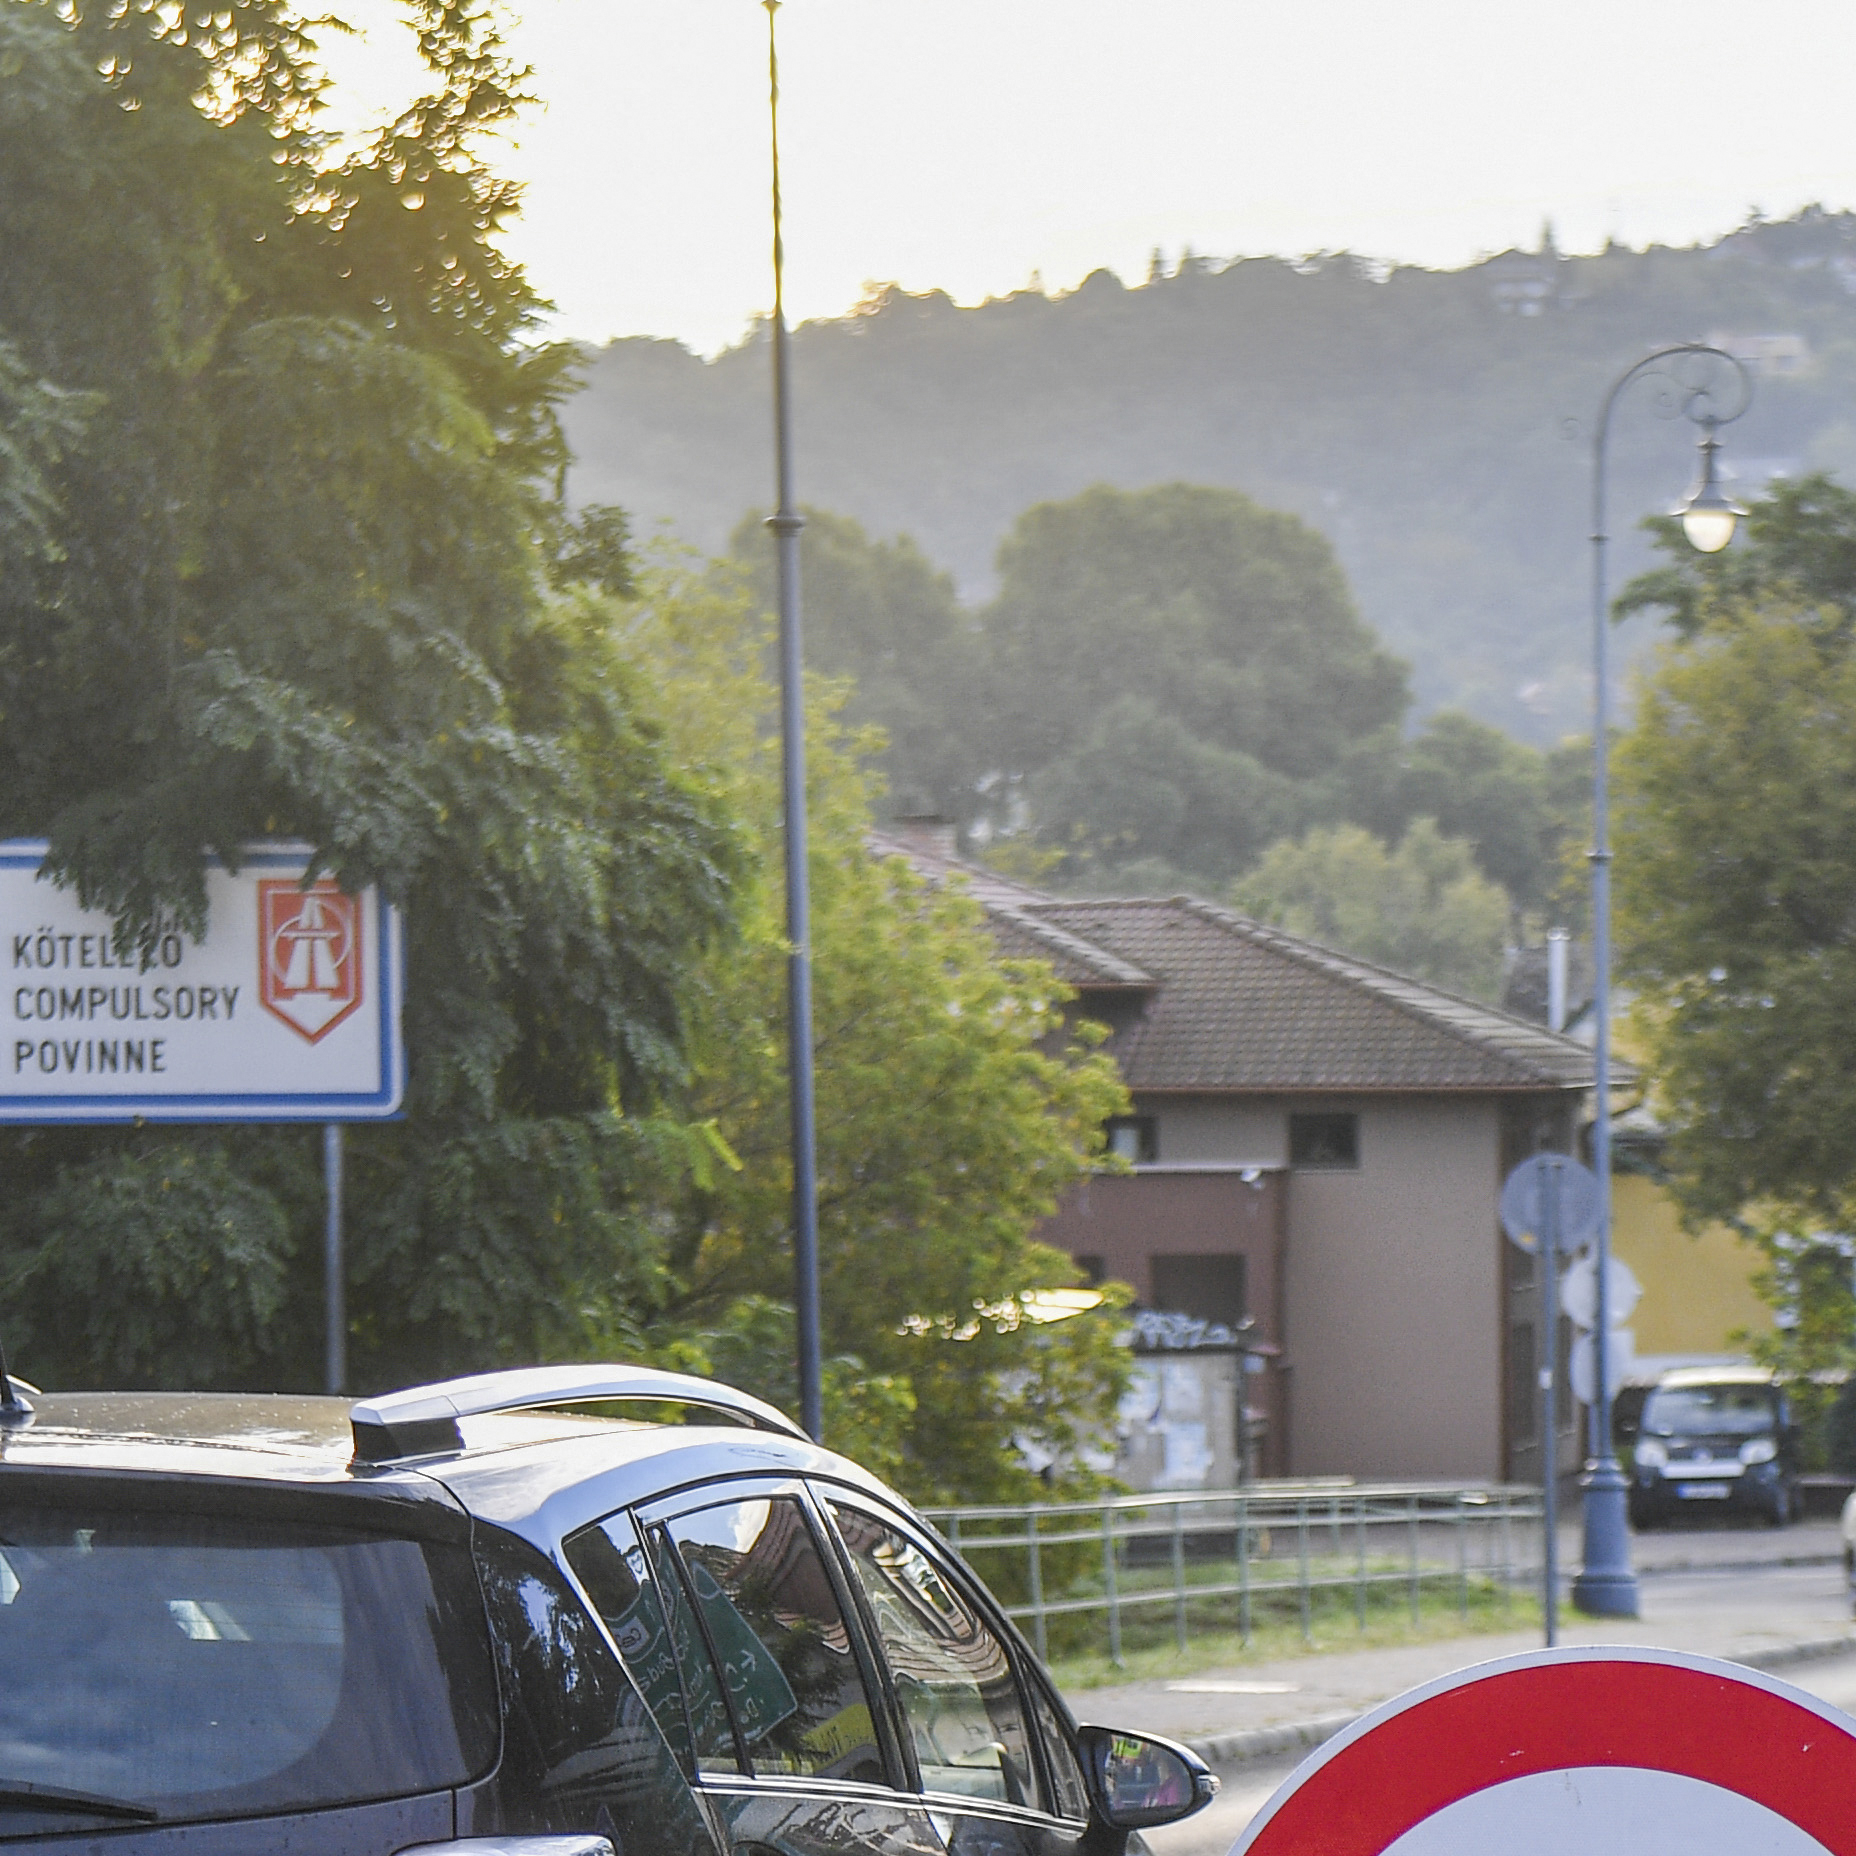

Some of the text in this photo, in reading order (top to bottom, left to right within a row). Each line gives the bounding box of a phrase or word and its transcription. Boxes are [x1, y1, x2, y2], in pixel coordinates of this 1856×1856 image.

[13, 922, 182, 968] KÖTELŐ
[14, 986, 240, 1021] COMPULSORY
[14, 1040, 167, 1074] POVINNE
